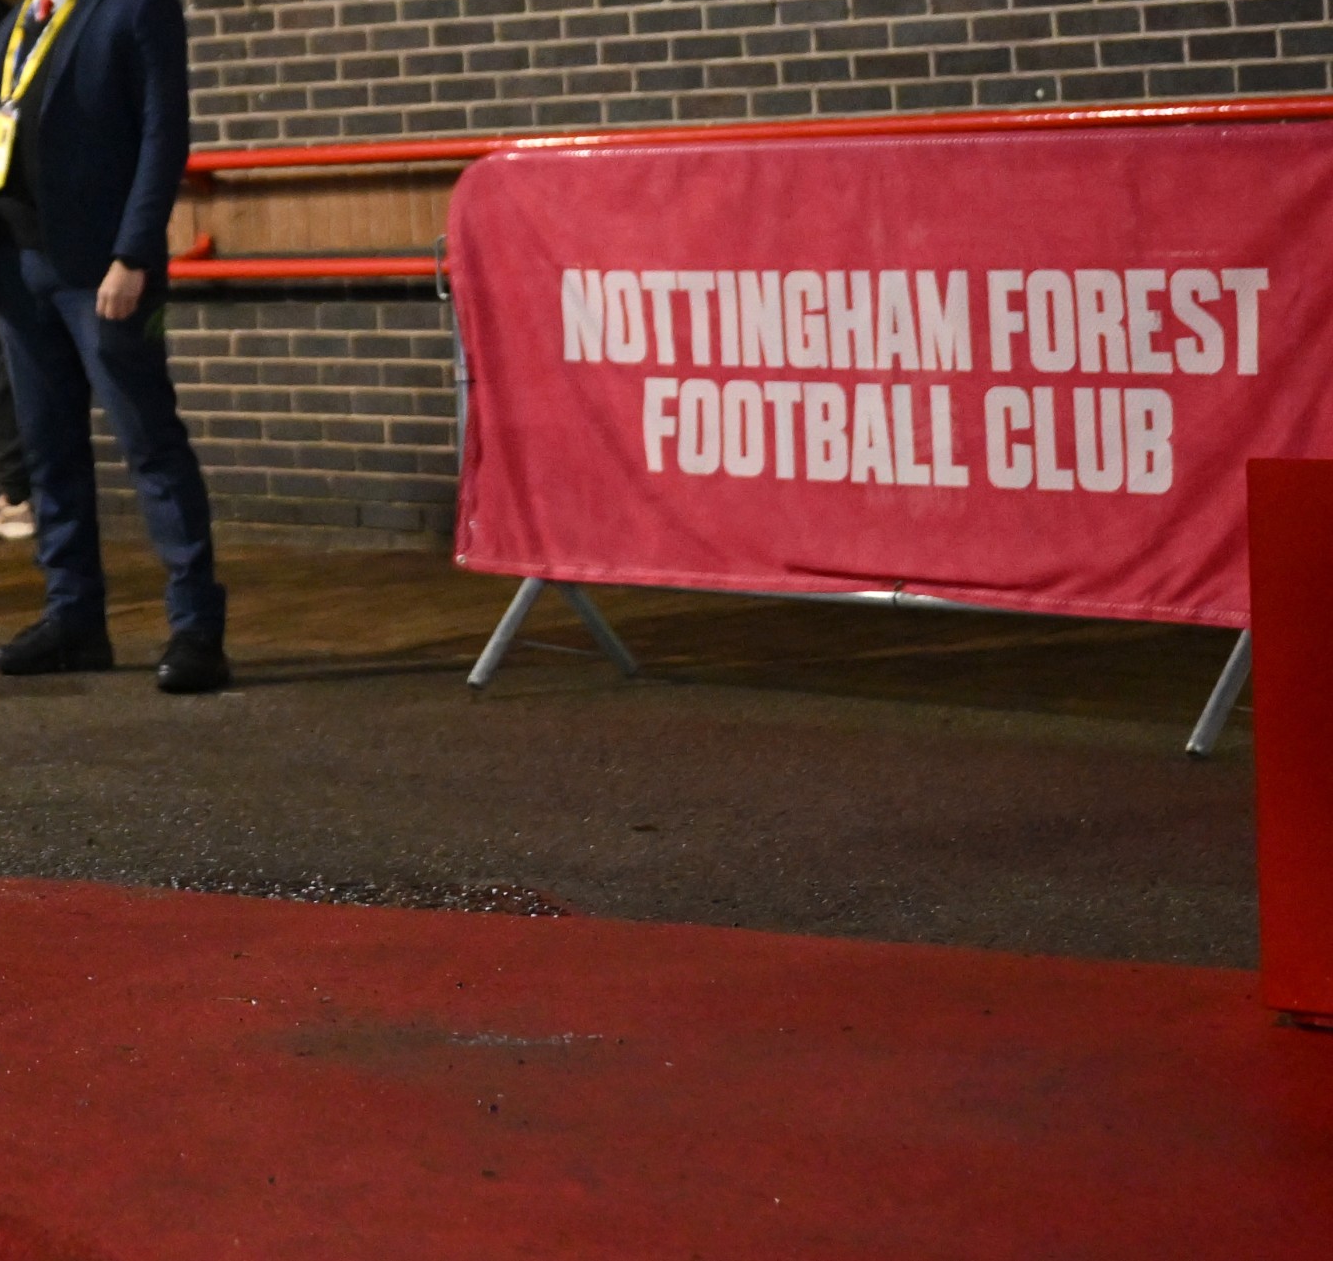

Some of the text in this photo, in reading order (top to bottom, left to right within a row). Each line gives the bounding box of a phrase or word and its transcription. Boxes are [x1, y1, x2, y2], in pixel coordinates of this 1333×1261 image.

[561, 267, 1271, 376] NOTTINGHAM FOREST
[642, 376, 1174, 495] FOOTBALL CLUB
